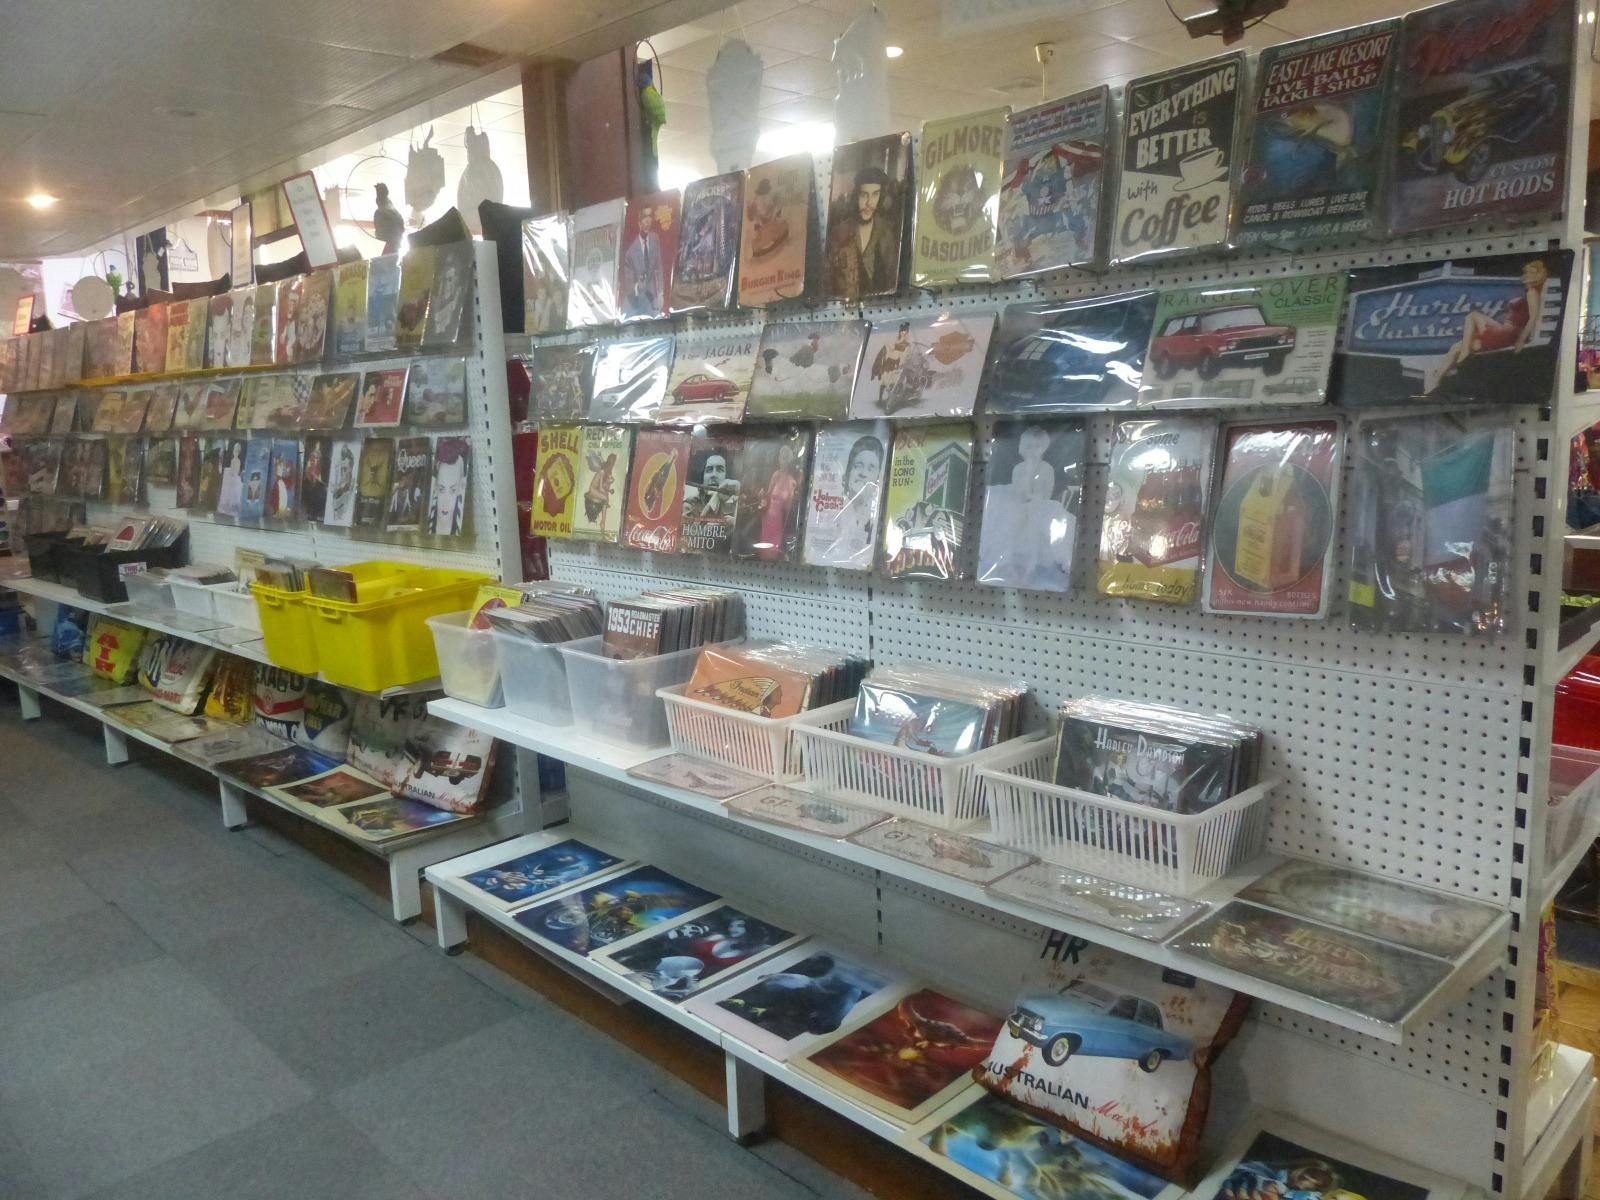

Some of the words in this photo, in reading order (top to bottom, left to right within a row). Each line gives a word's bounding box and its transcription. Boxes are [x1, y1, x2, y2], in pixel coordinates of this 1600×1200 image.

[1268, 58, 1303, 85] EAST
[1301, 50, 1337, 77] LAKE
[1337, 35, 1392, 67] RESORT
[1263, 87, 1322, 108] TACKLE
[1327, 72, 1377, 94] SHOP
[1264, 79, 1309, 97] LIVE
[1313, 66, 1361, 86] BAIT
[1129, 65, 1236, 136] EVERYTHING
[1192, 110, 1207, 125] is
[925, 125, 1003, 170] GILMORE
[1136, 127, 1213, 169] BETTER
[1489, 155, 1556, 178] CUSTOM
[1127, 181, 1158, 201] with
[1443, 184, 1490, 210] HOT
[1493, 171, 1555, 201] RODS
[1120, 192, 1220, 249] Coffee
[920, 230, 993, 262] GASOLINE
[741, 274, 776, 291] BURGER
[776, 269, 801, 283] KING
[1163, 291, 1241, 308] RANGE
[1251, 277, 1340, 298] ROVER
[1274, 293, 1337, 309] CLASSIC
[704, 343, 752, 360] JAGUAR
[540, 431, 579, 454] SHELL
[1146, 432, 1181, 446] some
[397, 448, 428, 473] Queen
[893, 467, 916, 477] LONG
[894, 456, 902, 466] in
[903, 455, 915, 466] the
[813, 488, 845, 503] Johnny
[533, 520, 558, 532] MOTOR
[559, 521, 572, 533] OIL
[682, 522, 727, 541] HOMBRE,
[687, 537, 715, 550] MITO
[608, 606, 631, 633] 1953
[630, 609, 662, 623] ROADMASTER
[629, 619, 660, 639] CHIEF
[1040, 929, 1089, 965] HR
